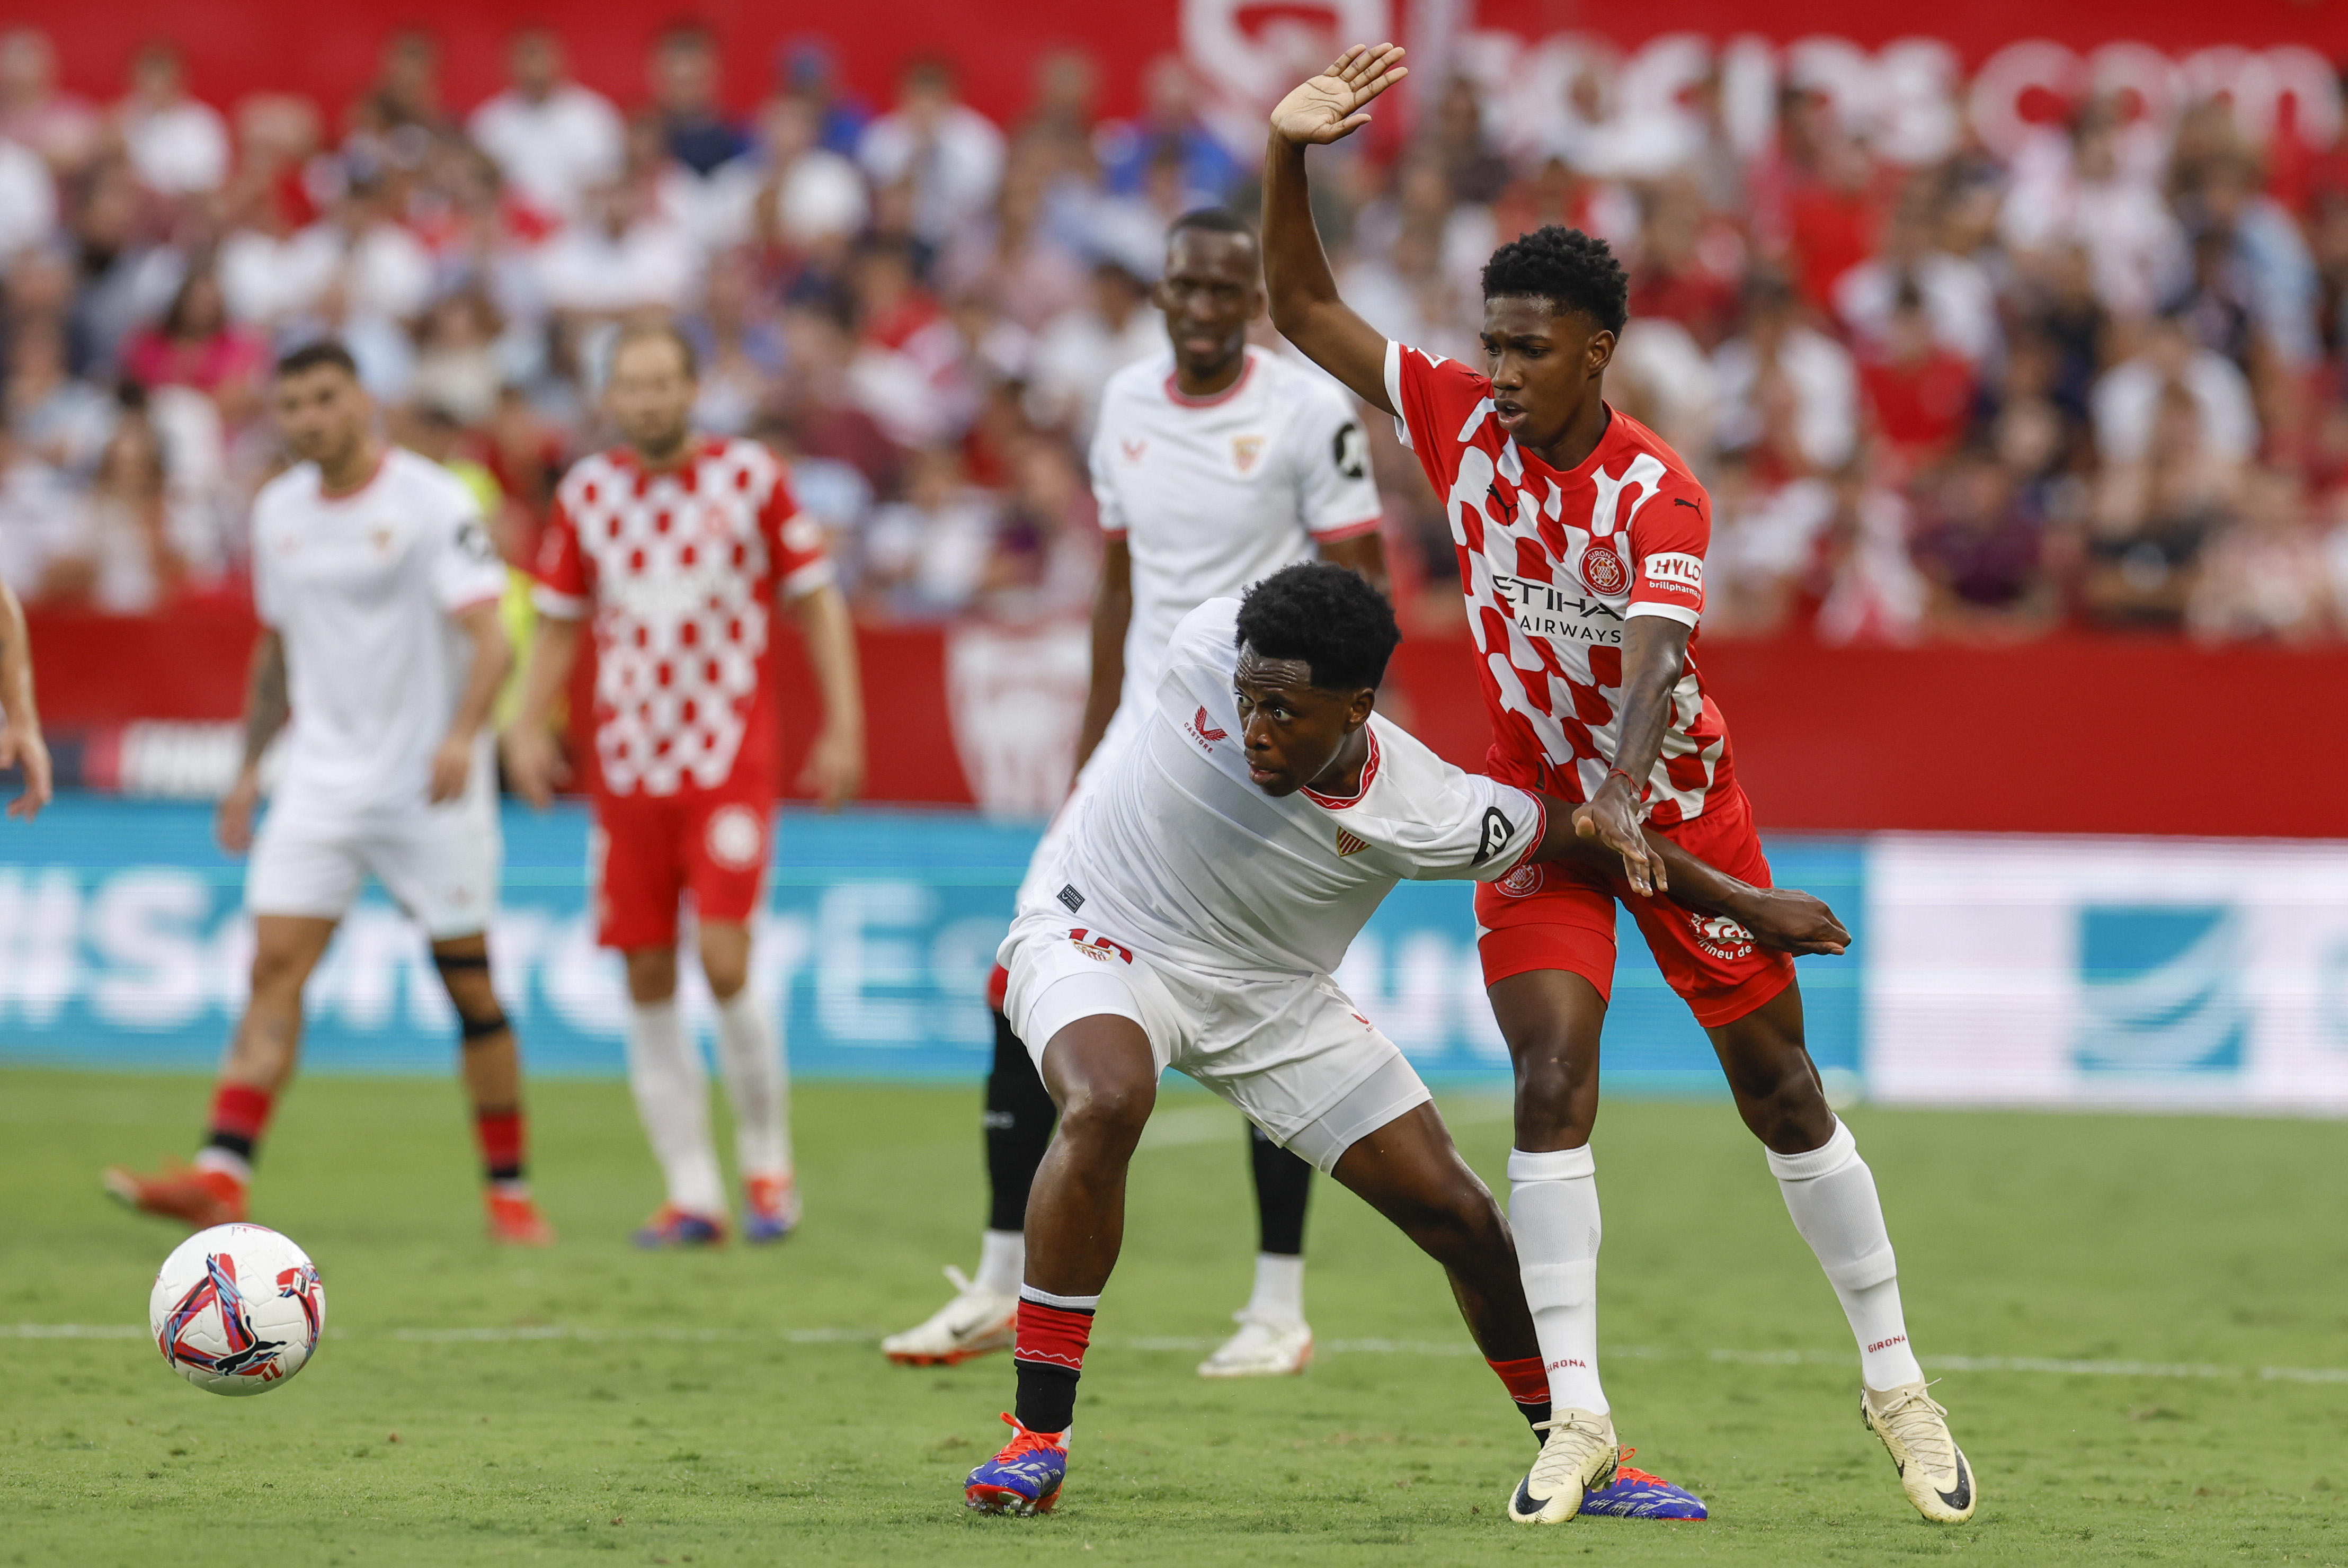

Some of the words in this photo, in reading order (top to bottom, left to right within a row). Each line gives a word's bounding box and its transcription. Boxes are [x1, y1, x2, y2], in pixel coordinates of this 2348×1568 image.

[1588, 550, 1616, 563] GIRONA
[1653, 558, 1701, 581] HYLO
[1593, 582, 1611, 592] FUTBOL
[1492, 574, 1625, 621] ETIHA
[1520, 614, 1622, 643] AIRWAYS
[1184, 721, 1214, 754] CASTORE
[1737, 945, 1753, 958] de
[1867, 1334, 1907, 1353] GIRONA
[1545, 1359, 1587, 1374] GIRONA
